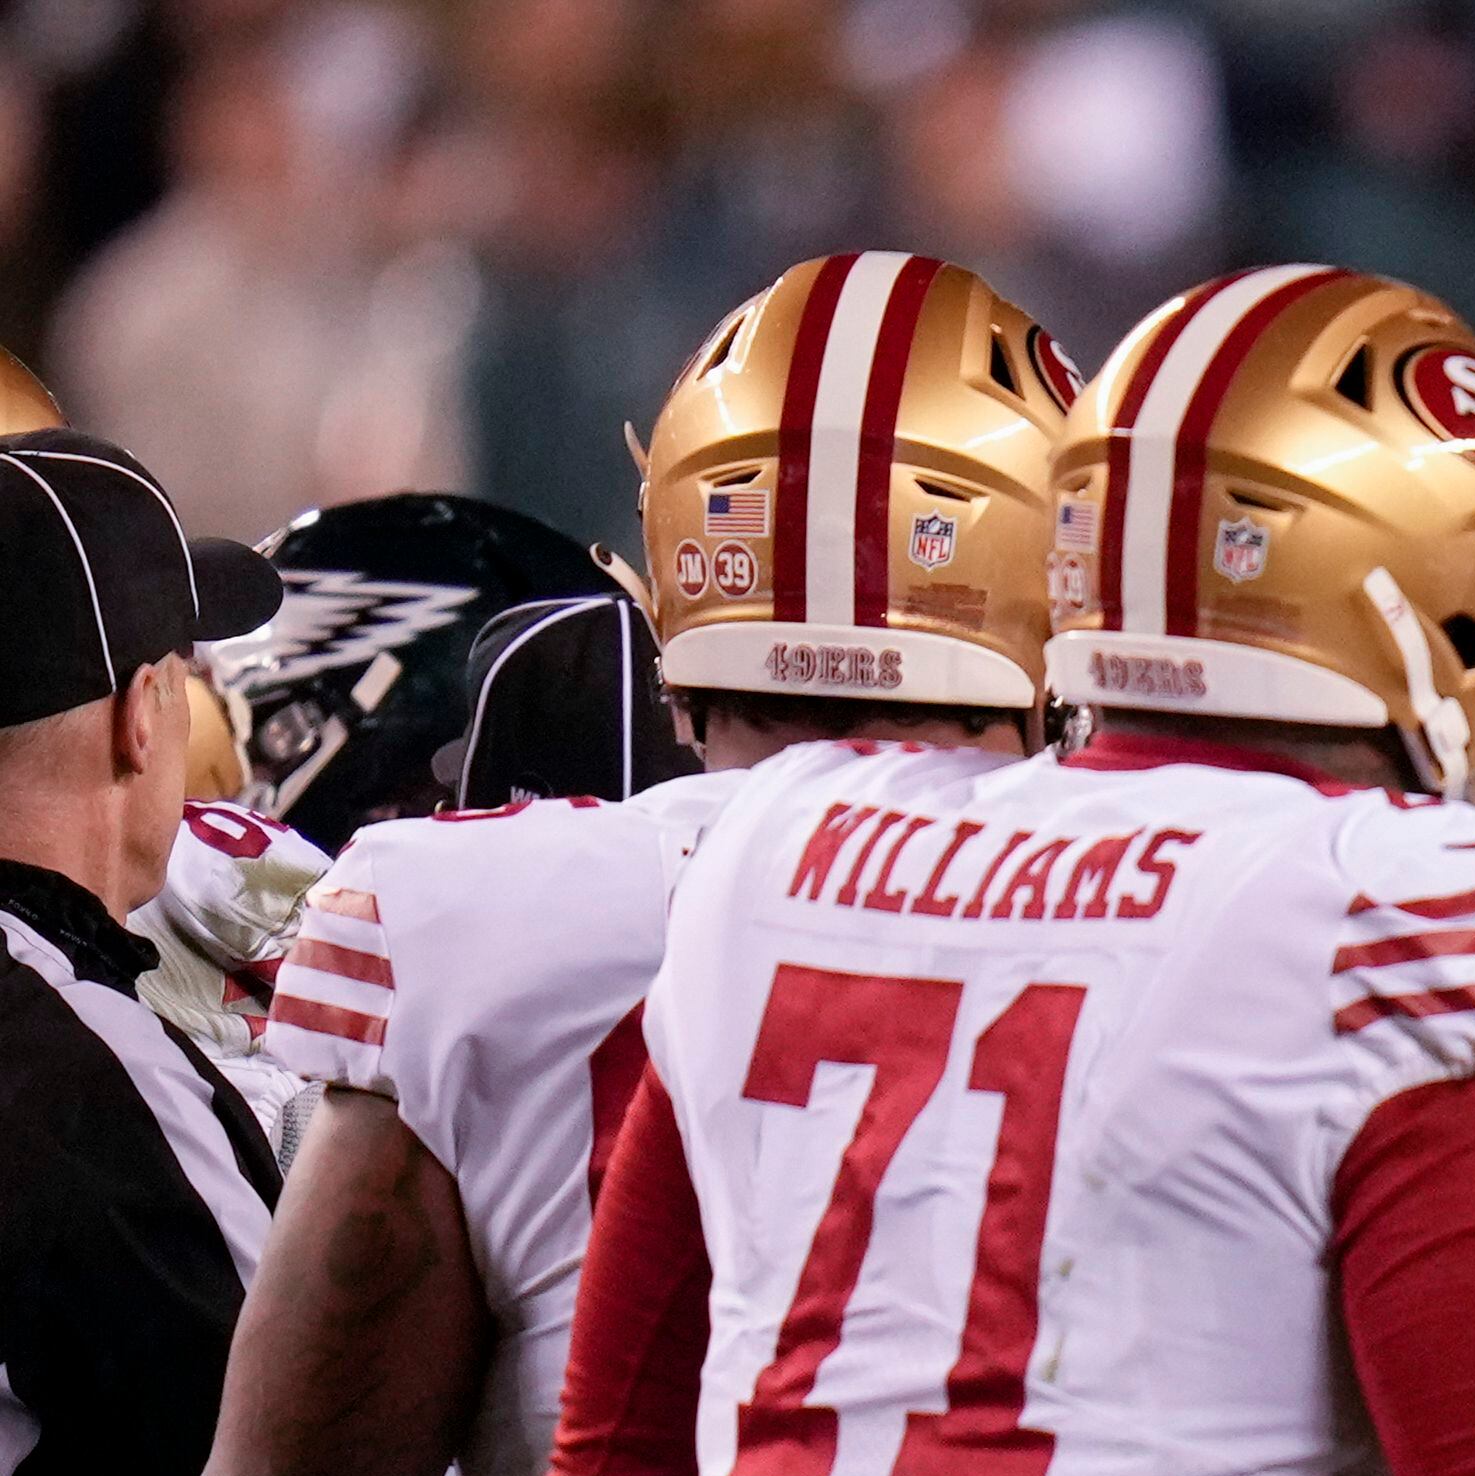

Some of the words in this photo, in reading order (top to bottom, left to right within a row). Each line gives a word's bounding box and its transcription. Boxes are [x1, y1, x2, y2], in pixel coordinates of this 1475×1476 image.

[916, 533, 946, 561] NFL
[678, 552, 704, 585] JM
[718, 551, 751, 588] 39
[764, 640, 903, 688] 49ERS
[788, 802, 1204, 919] WILLIAMS
